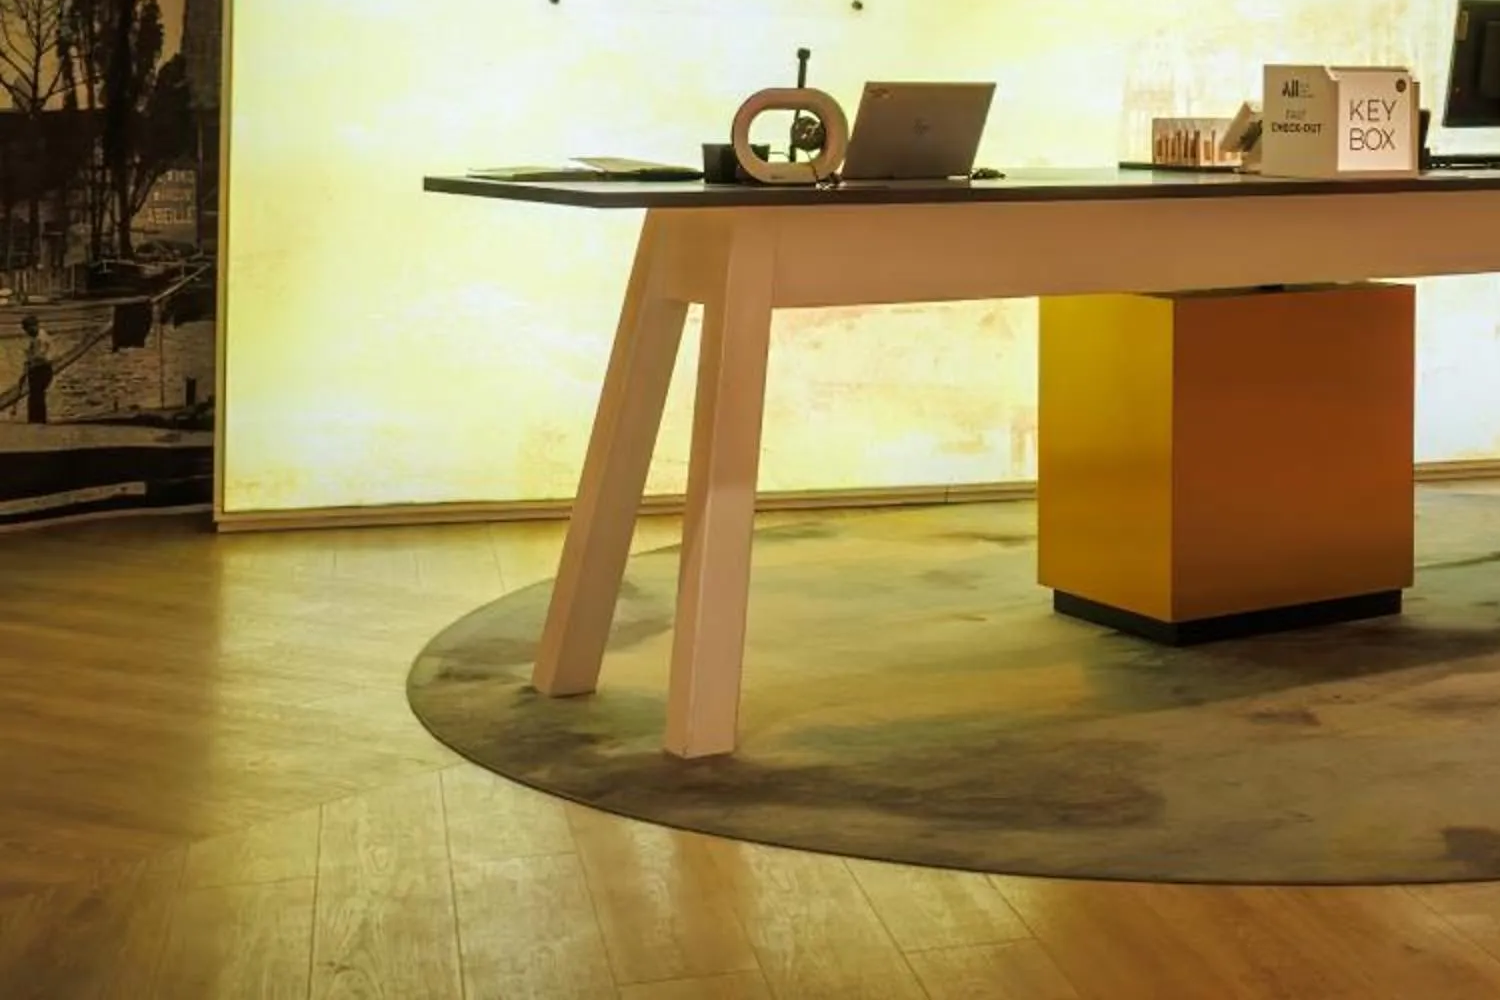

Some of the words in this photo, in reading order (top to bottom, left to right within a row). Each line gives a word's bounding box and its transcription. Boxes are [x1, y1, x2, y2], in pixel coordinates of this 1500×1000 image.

[1349, 99, 1398, 121] KEY
[1271, 121, 1322, 136] CHECK-OUT
[1349, 127, 1396, 151] BOX
